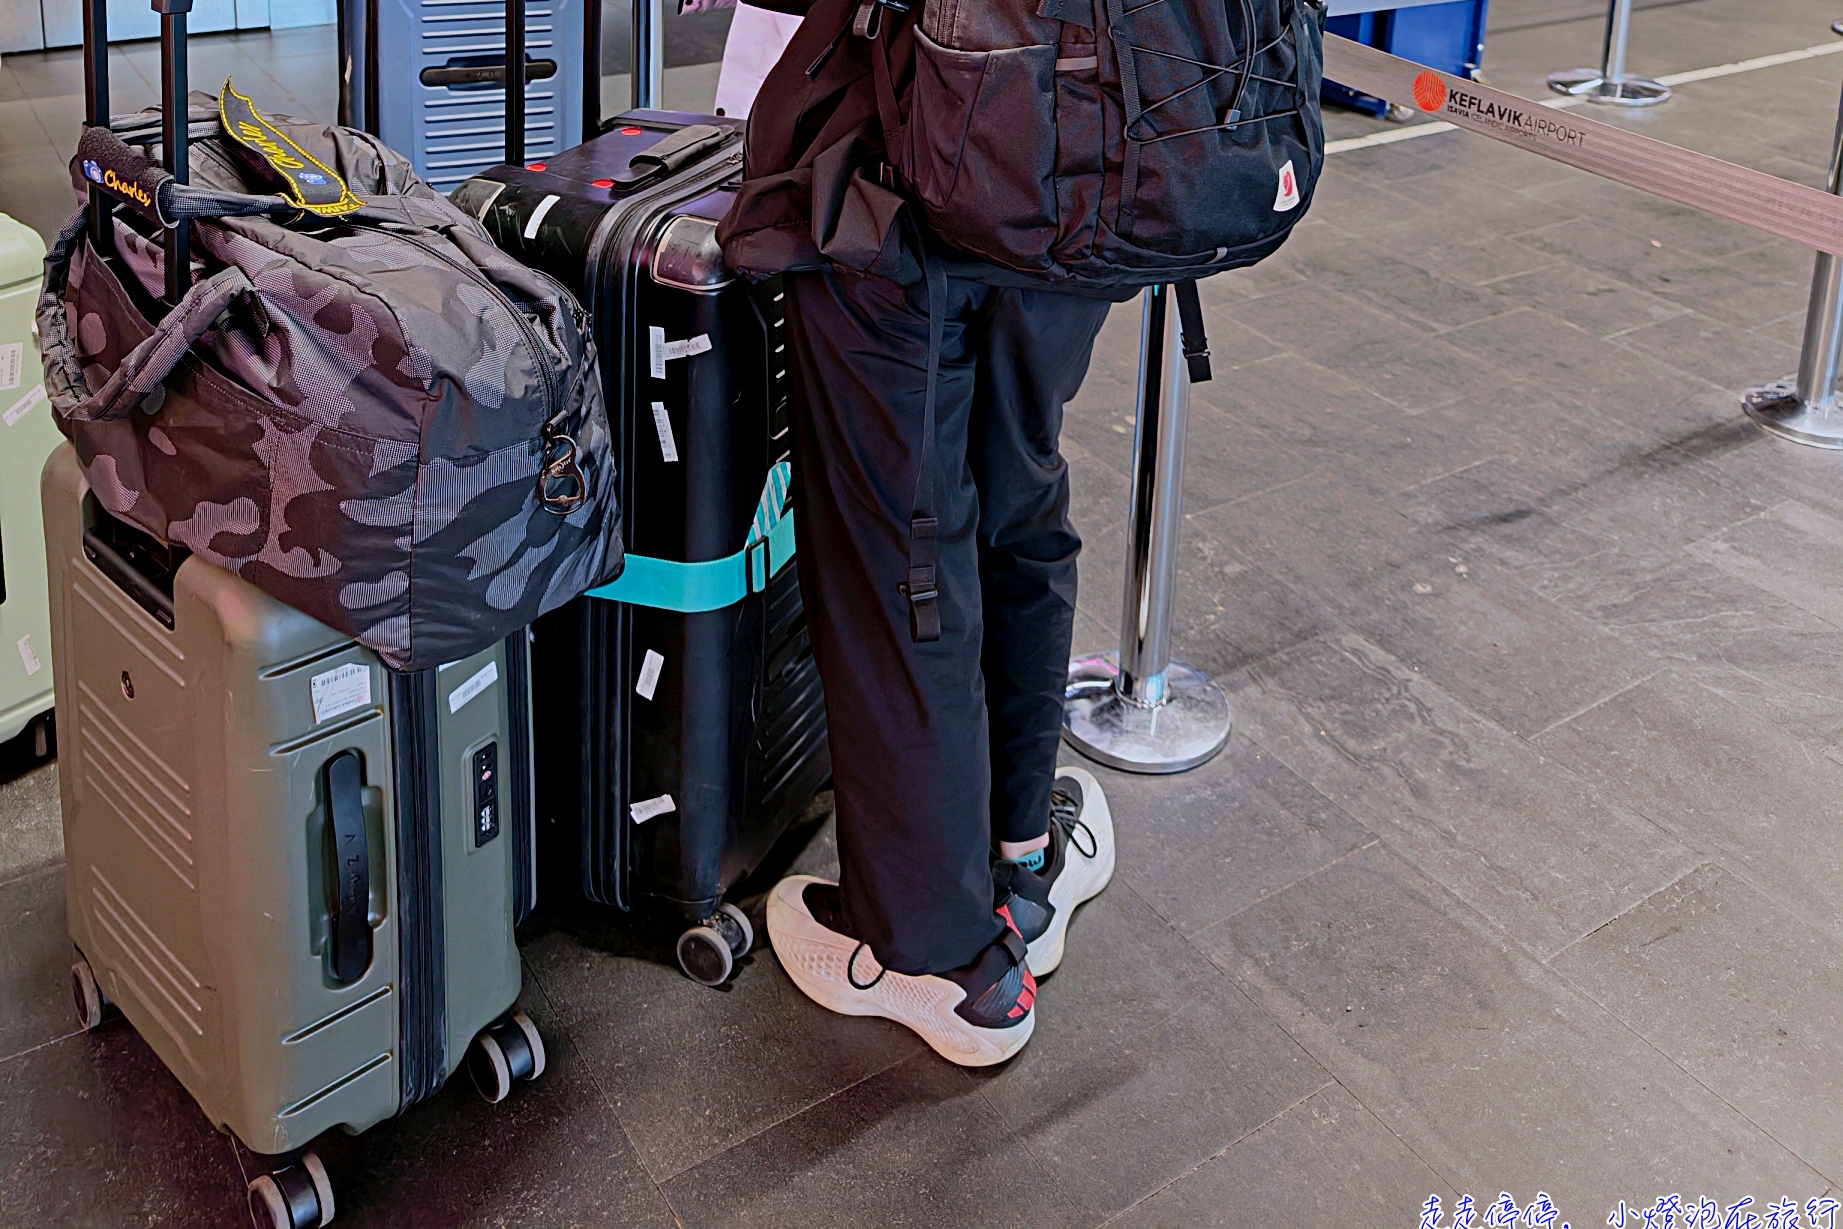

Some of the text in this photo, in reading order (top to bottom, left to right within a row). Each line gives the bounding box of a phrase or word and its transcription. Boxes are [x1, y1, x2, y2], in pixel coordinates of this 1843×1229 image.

[1446, 103, 1469, 119] ISAVIA
[1448, 87, 1587, 149] KEFLAVIK AIRPORT
